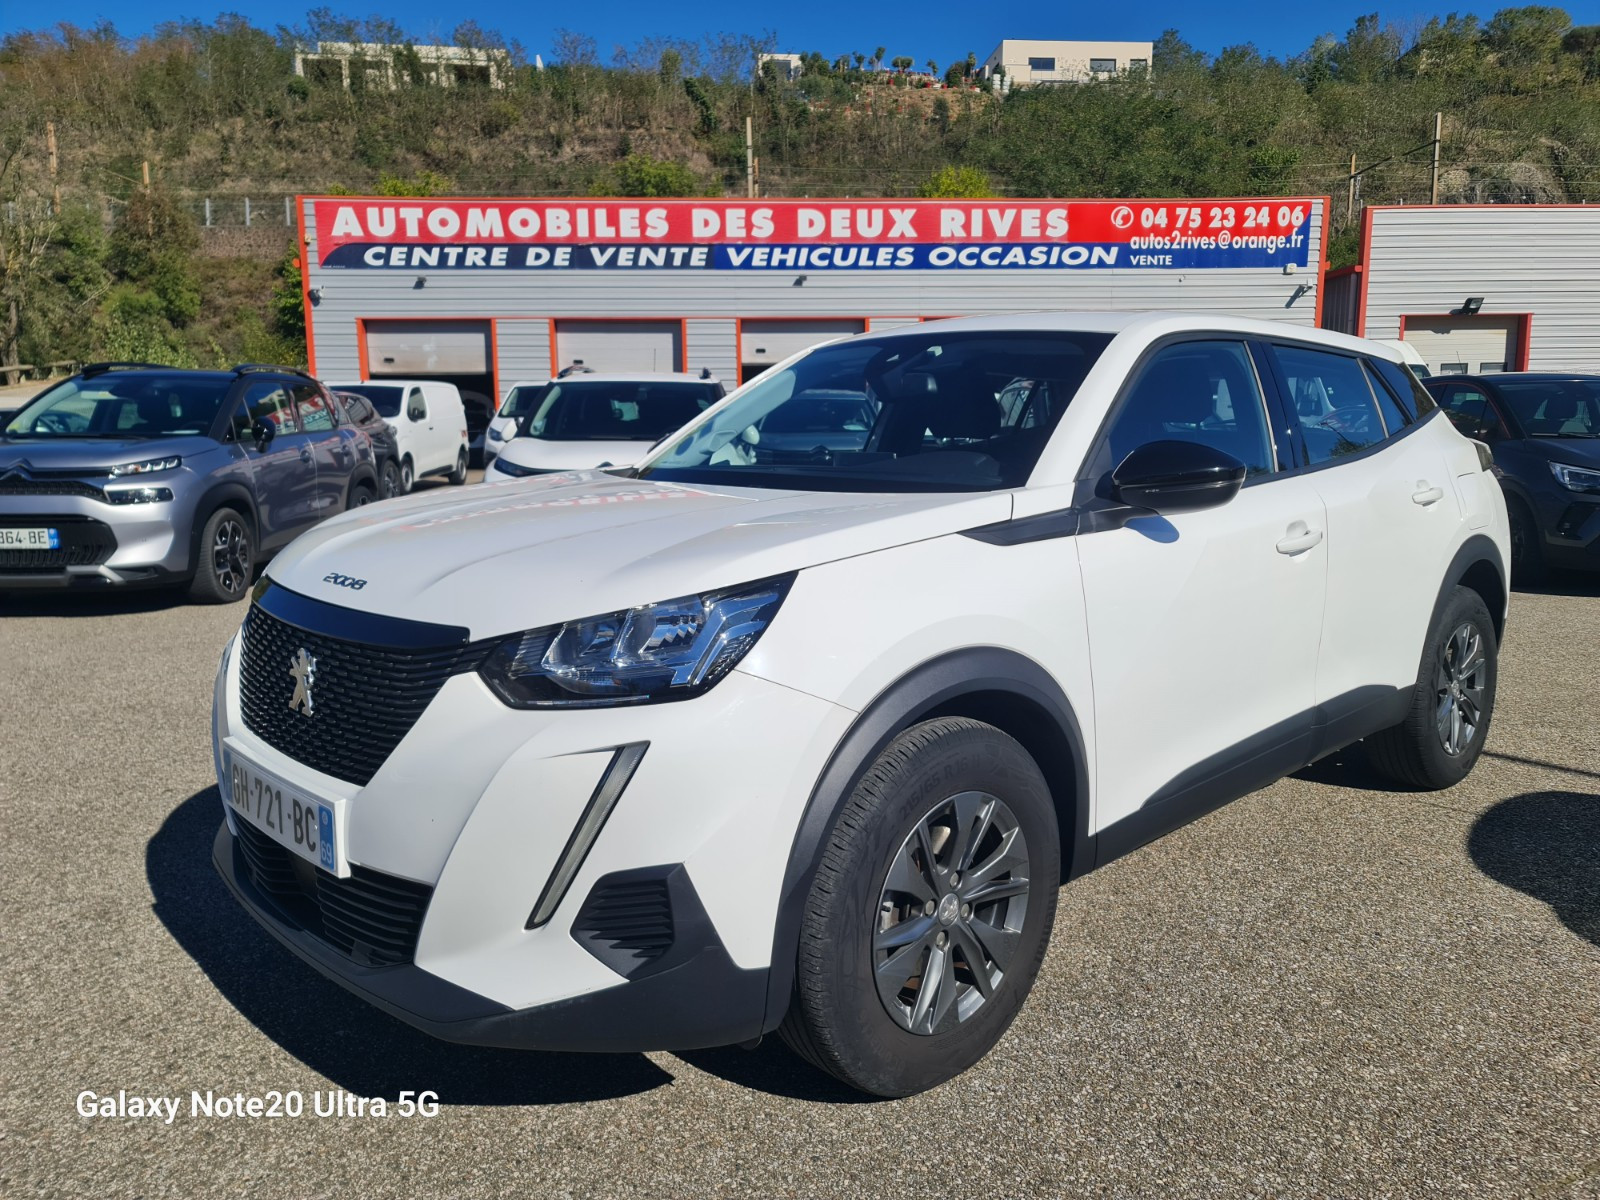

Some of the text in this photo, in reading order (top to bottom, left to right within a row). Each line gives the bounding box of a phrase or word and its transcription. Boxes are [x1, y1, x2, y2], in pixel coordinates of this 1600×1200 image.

[331, 206, 1069, 238] AUTOMOBILES DES DEUX RIVES
[1140, 205, 1304, 229] 04 75 23 24 06
[1130, 227, 1304, 254] autos2rives@orange.fr
[363, 246, 1119, 267] CENTRE DE VENTE VEHICULES OCCASION
[1129, 255, 1173, 266] VENTE
[322, 572, 368, 590] 2008
[232, 763, 317, 852] GH-721-BC
[320, 840, 333, 864] 69
